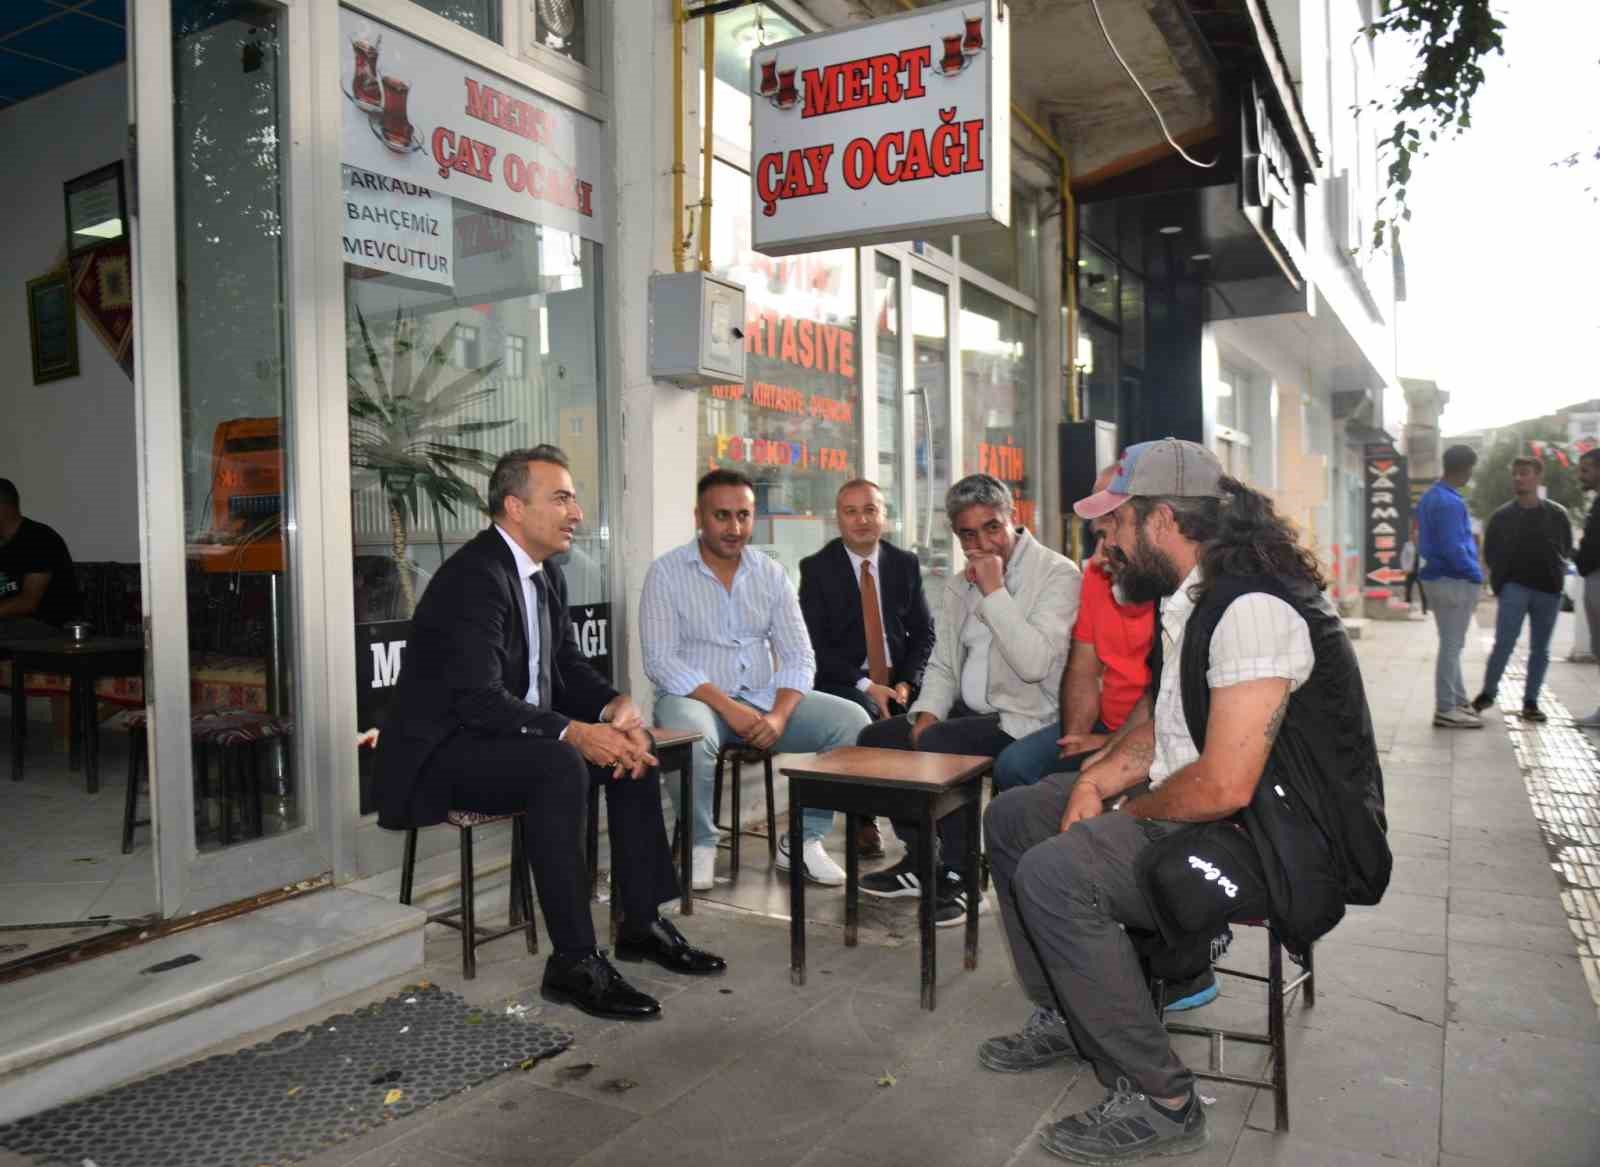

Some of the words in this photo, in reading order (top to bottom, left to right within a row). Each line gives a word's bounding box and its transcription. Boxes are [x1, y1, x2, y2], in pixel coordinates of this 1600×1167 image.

[801, 45, 931, 119] MERT
[431, 126, 496, 181] ÇAY
[757, 144, 834, 217] ÇAY
[843, 106, 984, 189] OCAĞI
[350, 171, 433, 199] ARKADA
[346, 202, 440, 237] BAHÇEMİZ
[342, 236, 449, 275] MEVCUTTUR
